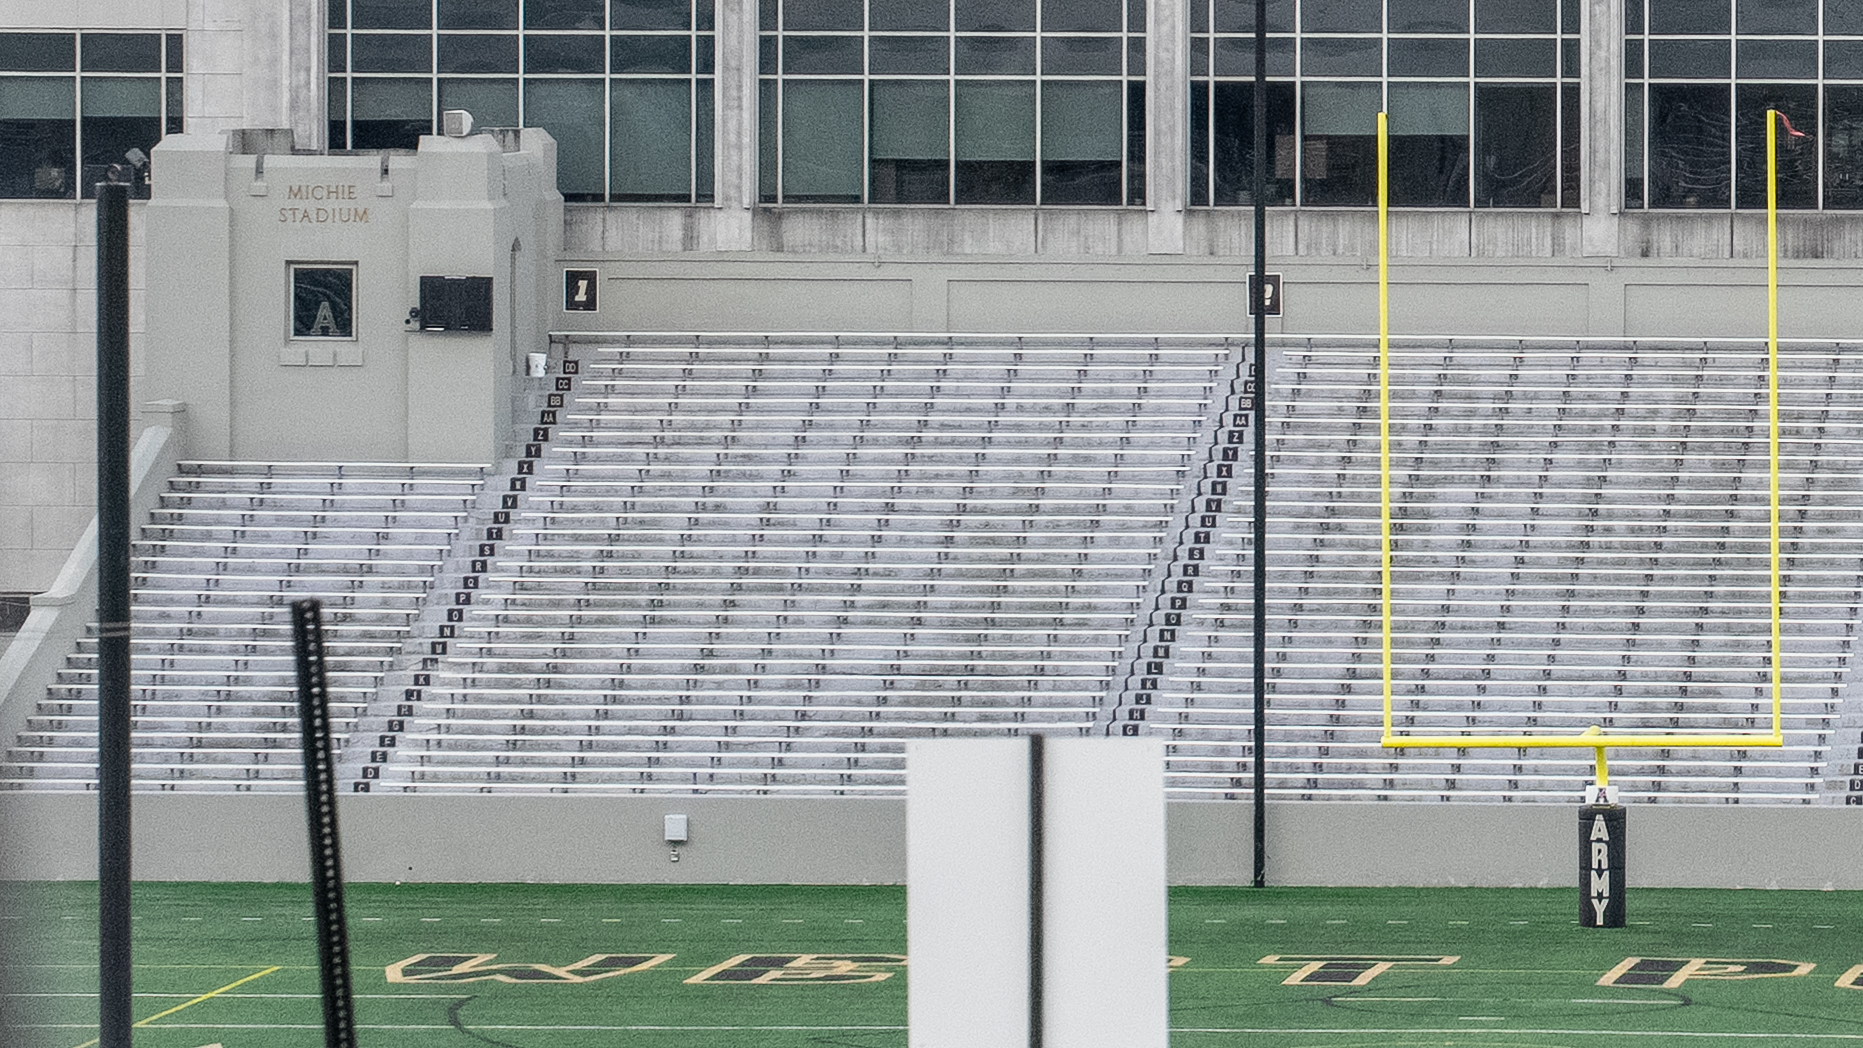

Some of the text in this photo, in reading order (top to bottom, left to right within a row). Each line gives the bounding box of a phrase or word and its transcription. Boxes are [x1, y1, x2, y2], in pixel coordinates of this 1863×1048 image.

[287, 184, 358, 201] MICHIE
[278, 207, 370, 224] STADIUM
[575, 280, 589, 303] 1
[310, 300, 341, 336] A
[565, 362, 576, 373] DD
[558, 379, 569, 389] CC
[543, 413, 554, 423] AA
[1235, 416, 1247, 426] AA
[537, 430, 544, 440] Z
[1232, 432, 1240, 443] Z
[530, 446, 536, 456] Y
[1227, 449, 1234, 460] Y
[522, 463, 529, 473] X
[1221, 466, 1228, 476] X
[506, 497, 513, 507] V
[1210, 501, 1217, 511] V
[498, 513, 505, 523] U
[1205, 516, 1213, 527] U
[491, 528, 498, 539] T
[1198, 533, 1206, 543] T
[483, 545, 491, 556] S
[1193, 549, 1200, 559] S
[475, 561, 482, 571] R
[1187, 565, 1194, 576] R
[467, 578, 475, 588] Q
[1181, 582, 1189, 592] Q
[459, 593, 467, 604] P
[1175, 598, 1182, 609] P
[443, 626, 451, 637] N
[1163, 630, 1171, 641] N
[1151, 662, 1159, 673] L
[418, 675, 426, 685] K
[1146, 679, 1153, 690] K
[410, 690, 418, 701] J
[1139, 693, 1147, 704] J
[1133, 709, 1141, 720] H
[392, 720, 399, 731] G
[1126, 725, 1134, 736] G
[376, 751, 383, 762] E
[367, 767, 375, 778] D
[1854, 779, 1861, 790] D
[1590, 813, 1611, 927] ARMY
